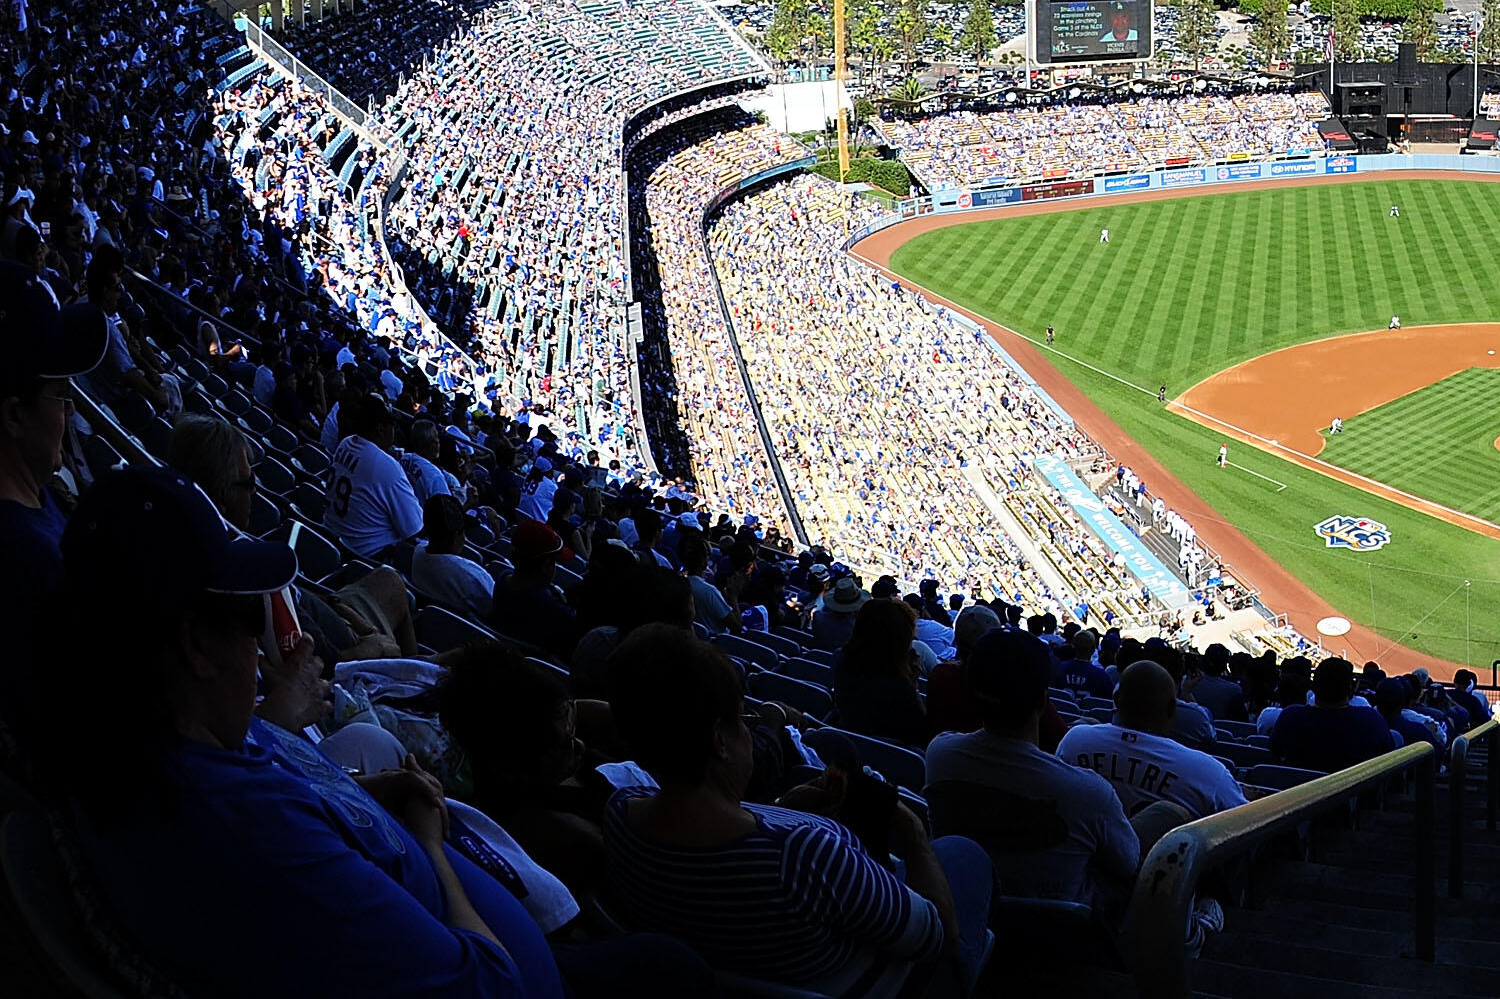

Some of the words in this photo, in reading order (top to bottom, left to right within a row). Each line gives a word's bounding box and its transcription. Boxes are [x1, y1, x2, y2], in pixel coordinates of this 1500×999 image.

[1285, 164, 1316, 172] HYUNDAI
[1056, 473, 1075, 489] THE
[1092, 513, 1135, 552] WELCOME
[1130, 552, 1154, 572] YOU
[1319, 516, 1388, 549] NLCS
[1065, 673, 1087, 687] KEMP
[1077, 752, 1178, 798] BELTRE
